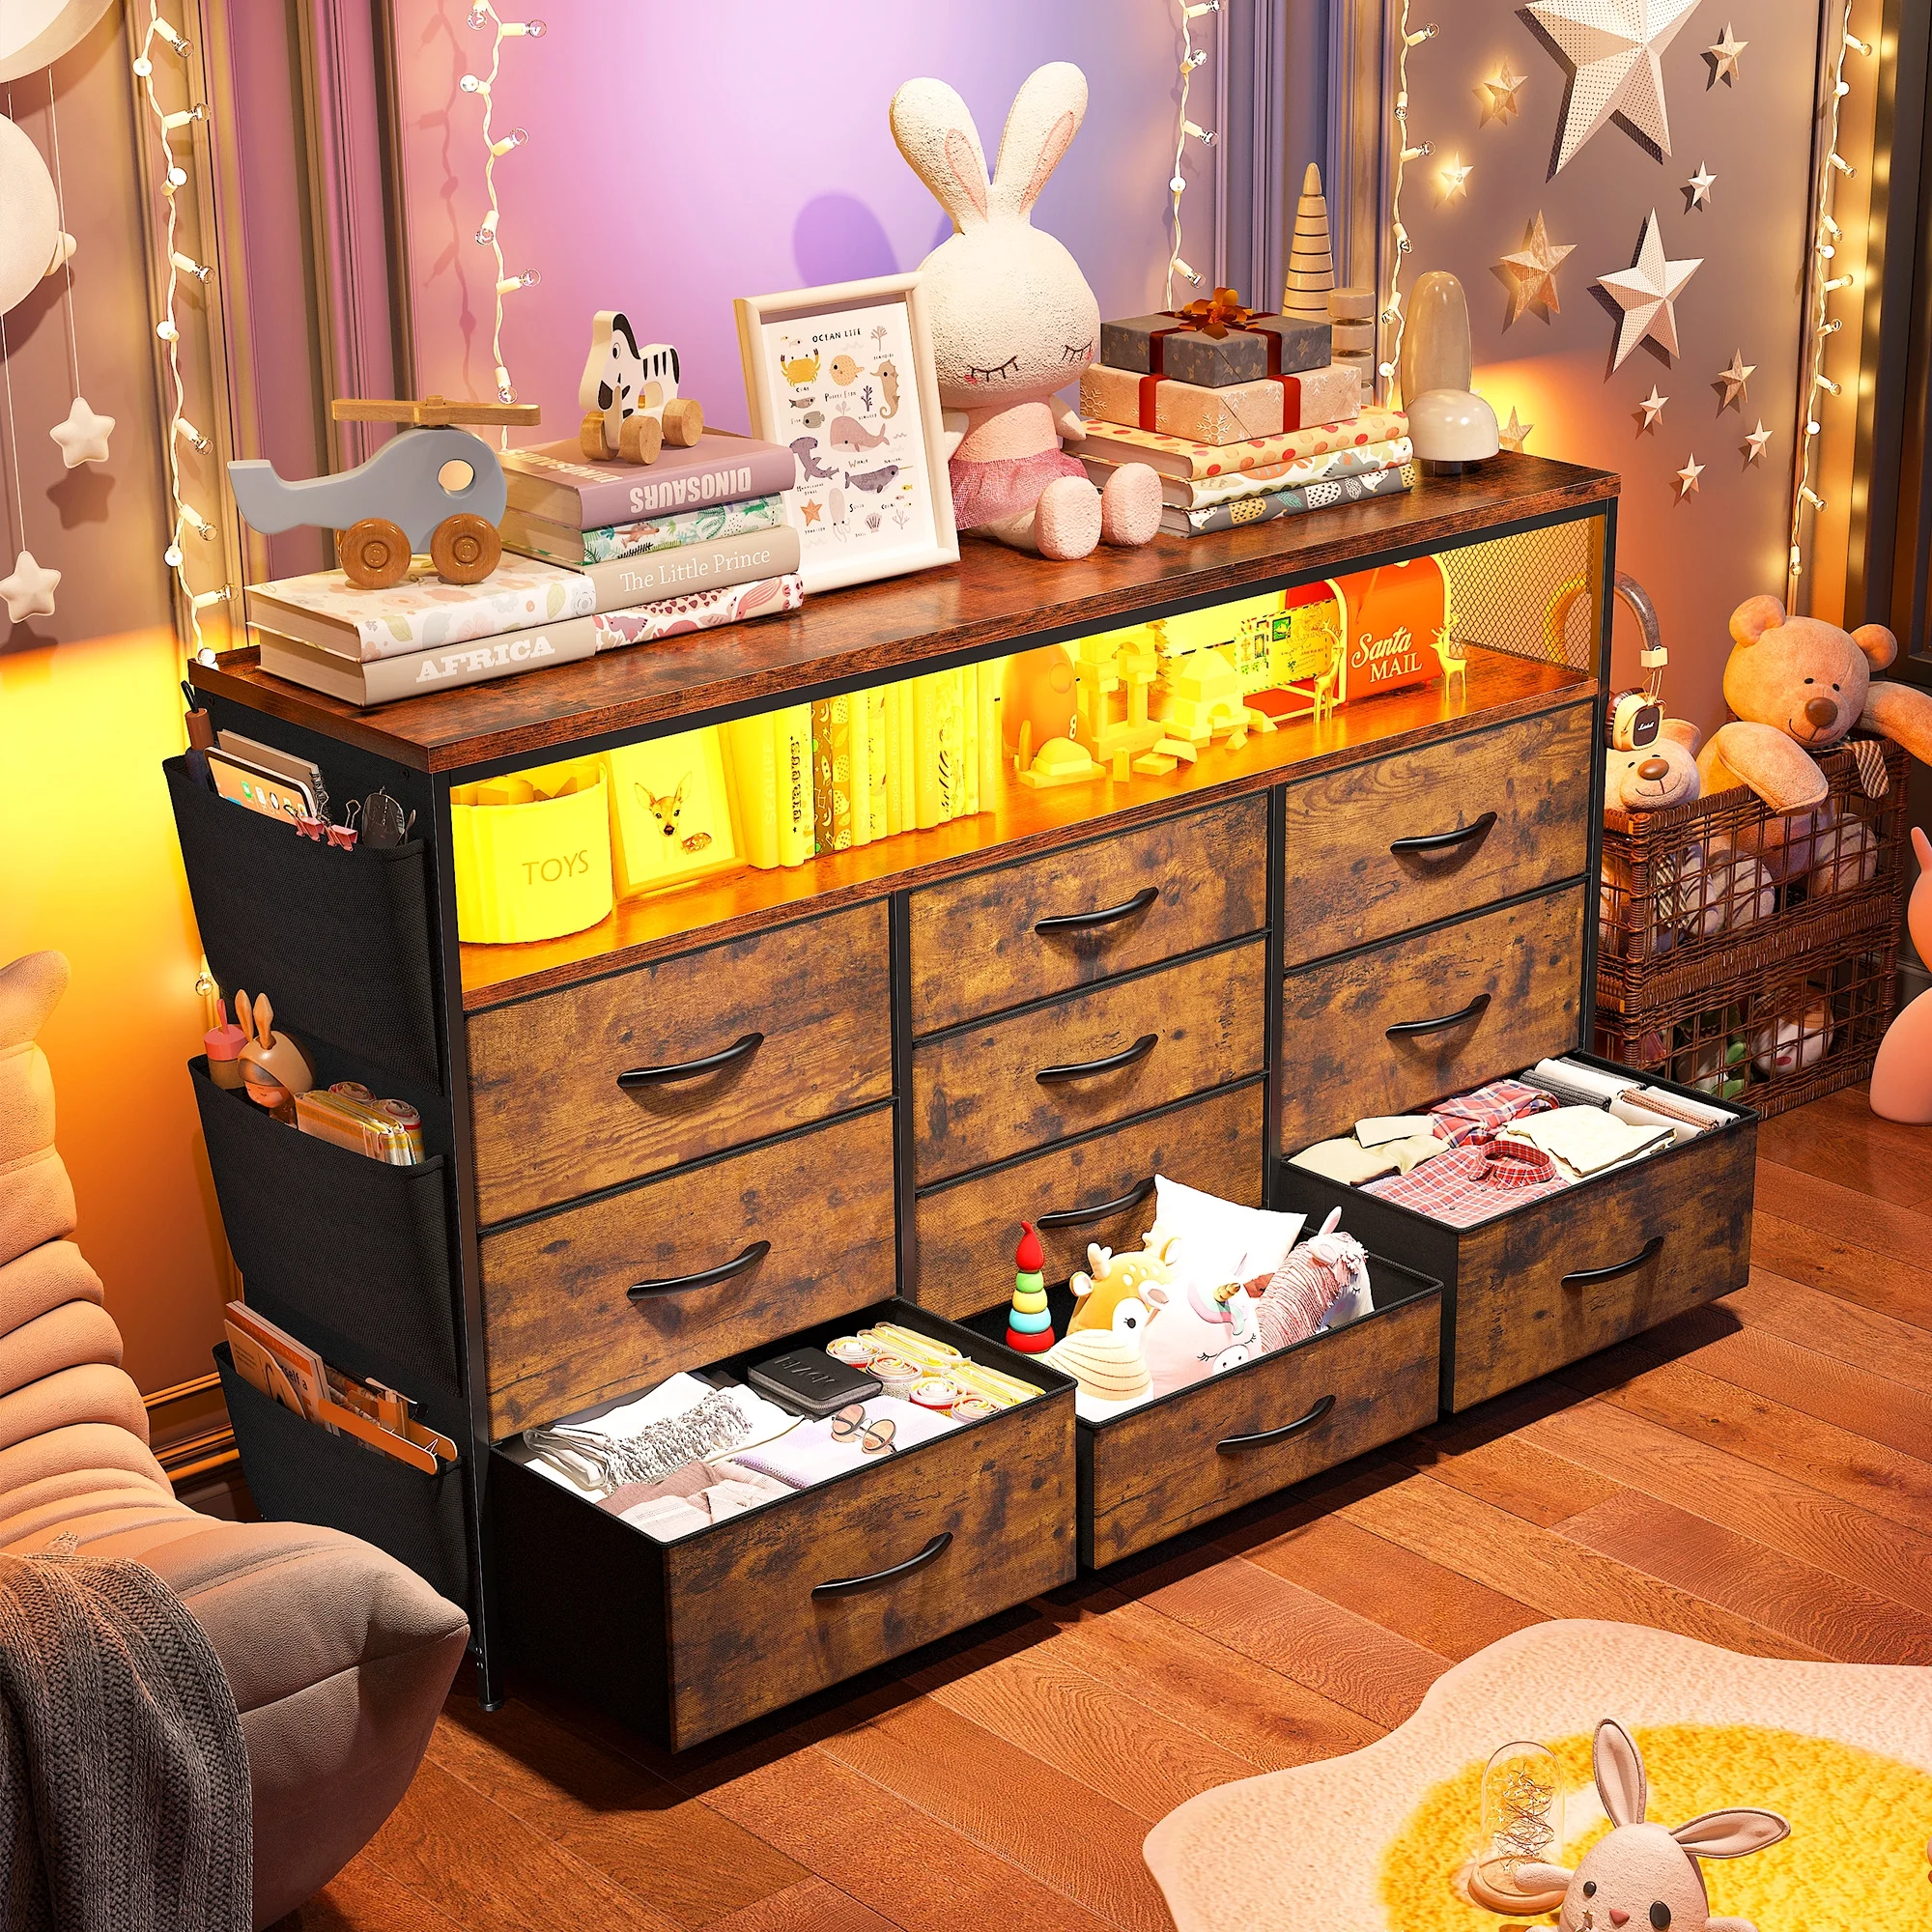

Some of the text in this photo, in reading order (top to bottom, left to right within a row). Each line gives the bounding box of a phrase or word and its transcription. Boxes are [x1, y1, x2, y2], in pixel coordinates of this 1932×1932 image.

[811, 327, 861, 343] OCEAN LIFE
[630, 467, 752, 513] DINOSAURS
[619, 550, 771, 592] The Little Prince
[415, 636, 555, 683] AFRICA
[1351, 626, 1412, 668] Santa
[1369, 652, 1423, 683] MAIL
[923, 694, 933, 793] Winnie The Pooh
[1068, 713, 1078, 739] 8
[762, 740, 777, 825] SEALIFE
[522, 850, 589, 885] TOYS
